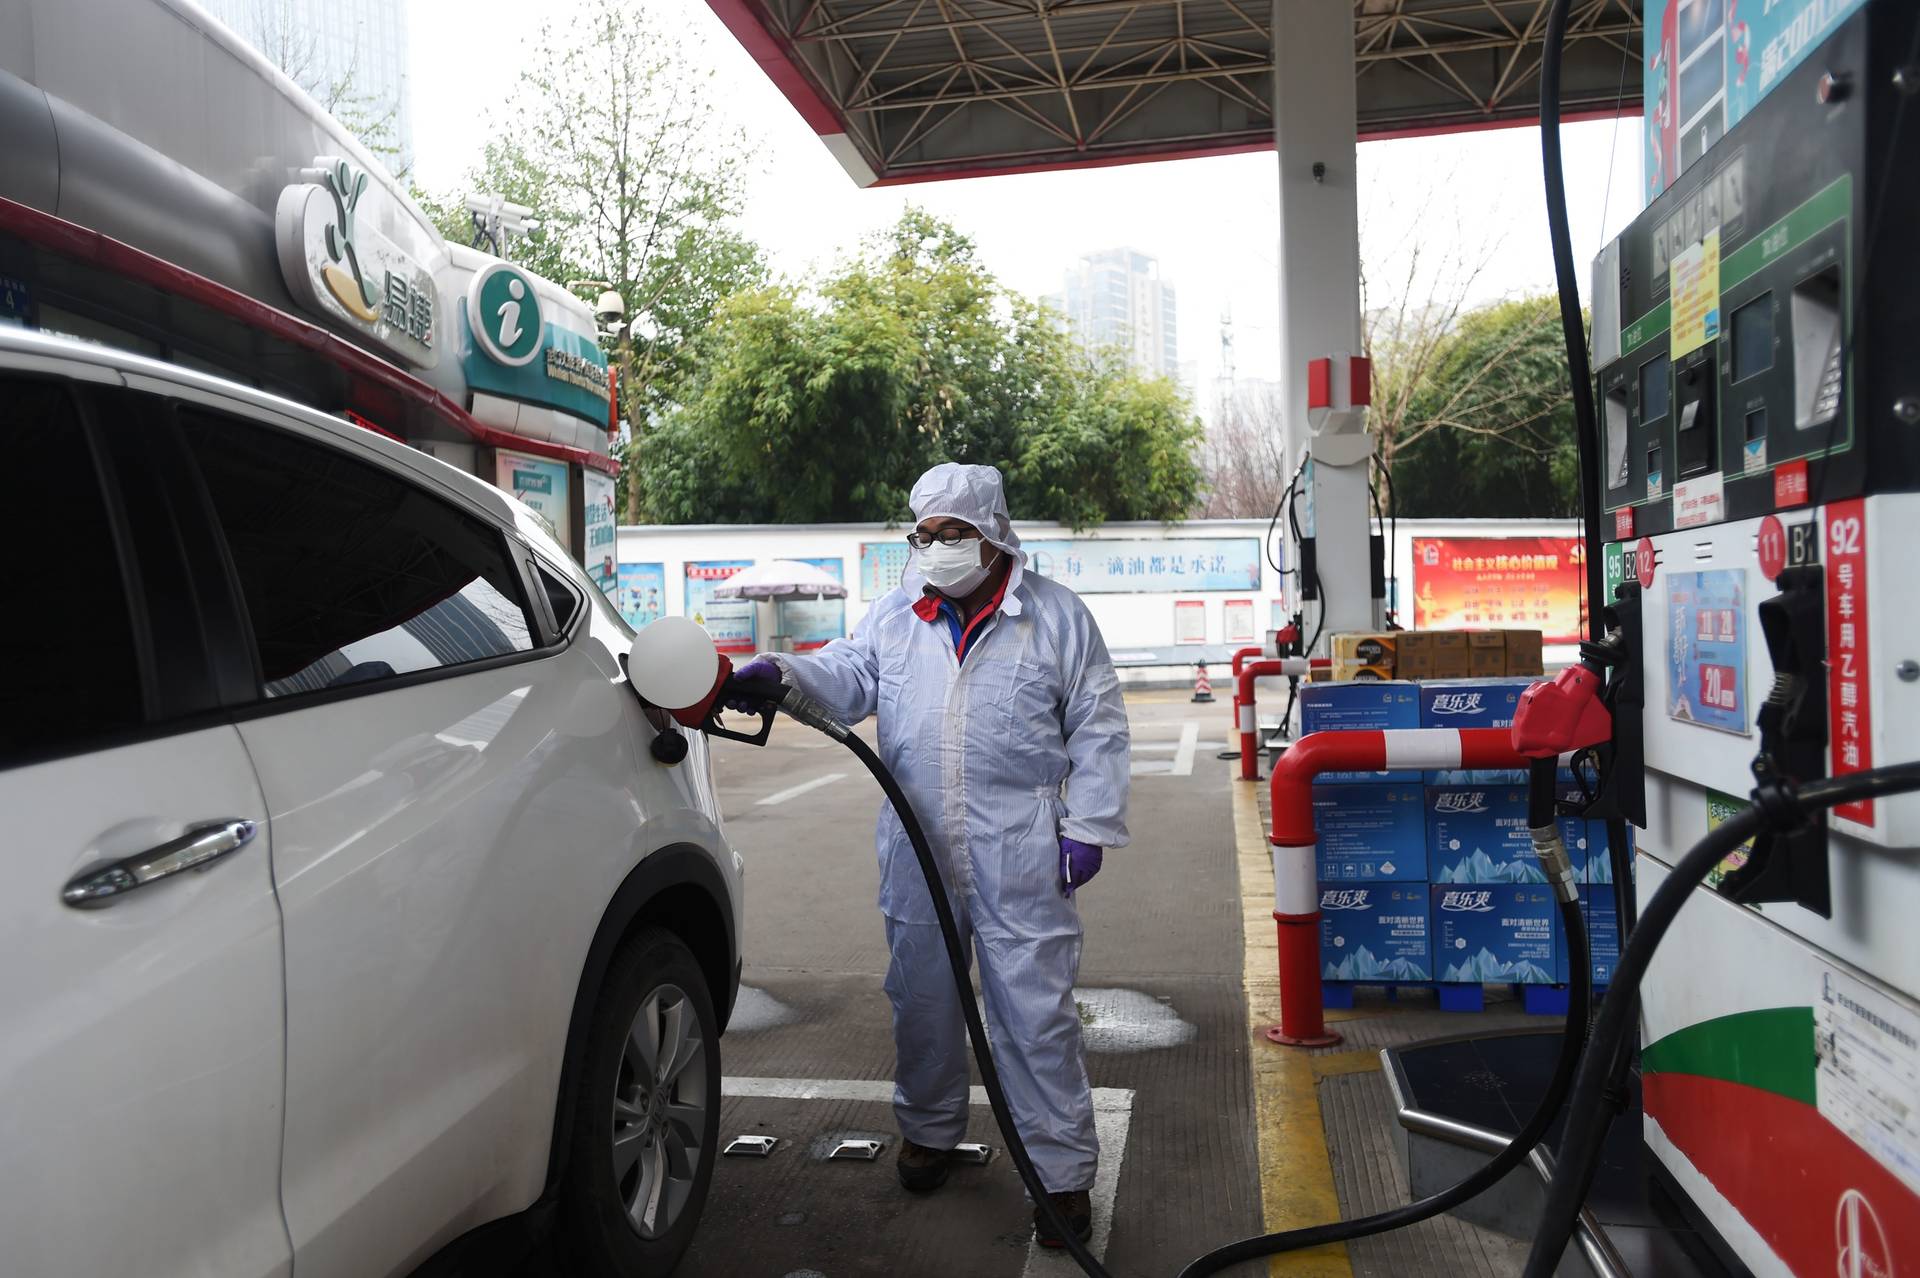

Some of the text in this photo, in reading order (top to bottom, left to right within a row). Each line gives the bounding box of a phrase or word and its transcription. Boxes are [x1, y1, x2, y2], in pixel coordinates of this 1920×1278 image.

[1831, 518, 1861, 555] 92
[1762, 534, 1780, 562] 11
[1609, 555, 1621, 579] 95
[1625, 553, 1637, 578] B2
[1639, 552, 1650, 573] 12
[1432, 693, 1486, 714] 喜乐爽
[1435, 792, 1489, 813] 喜乐爽
[1320, 889, 1373, 911] 喜乐爽
[1441, 891, 1496, 912] 喜乐爽
